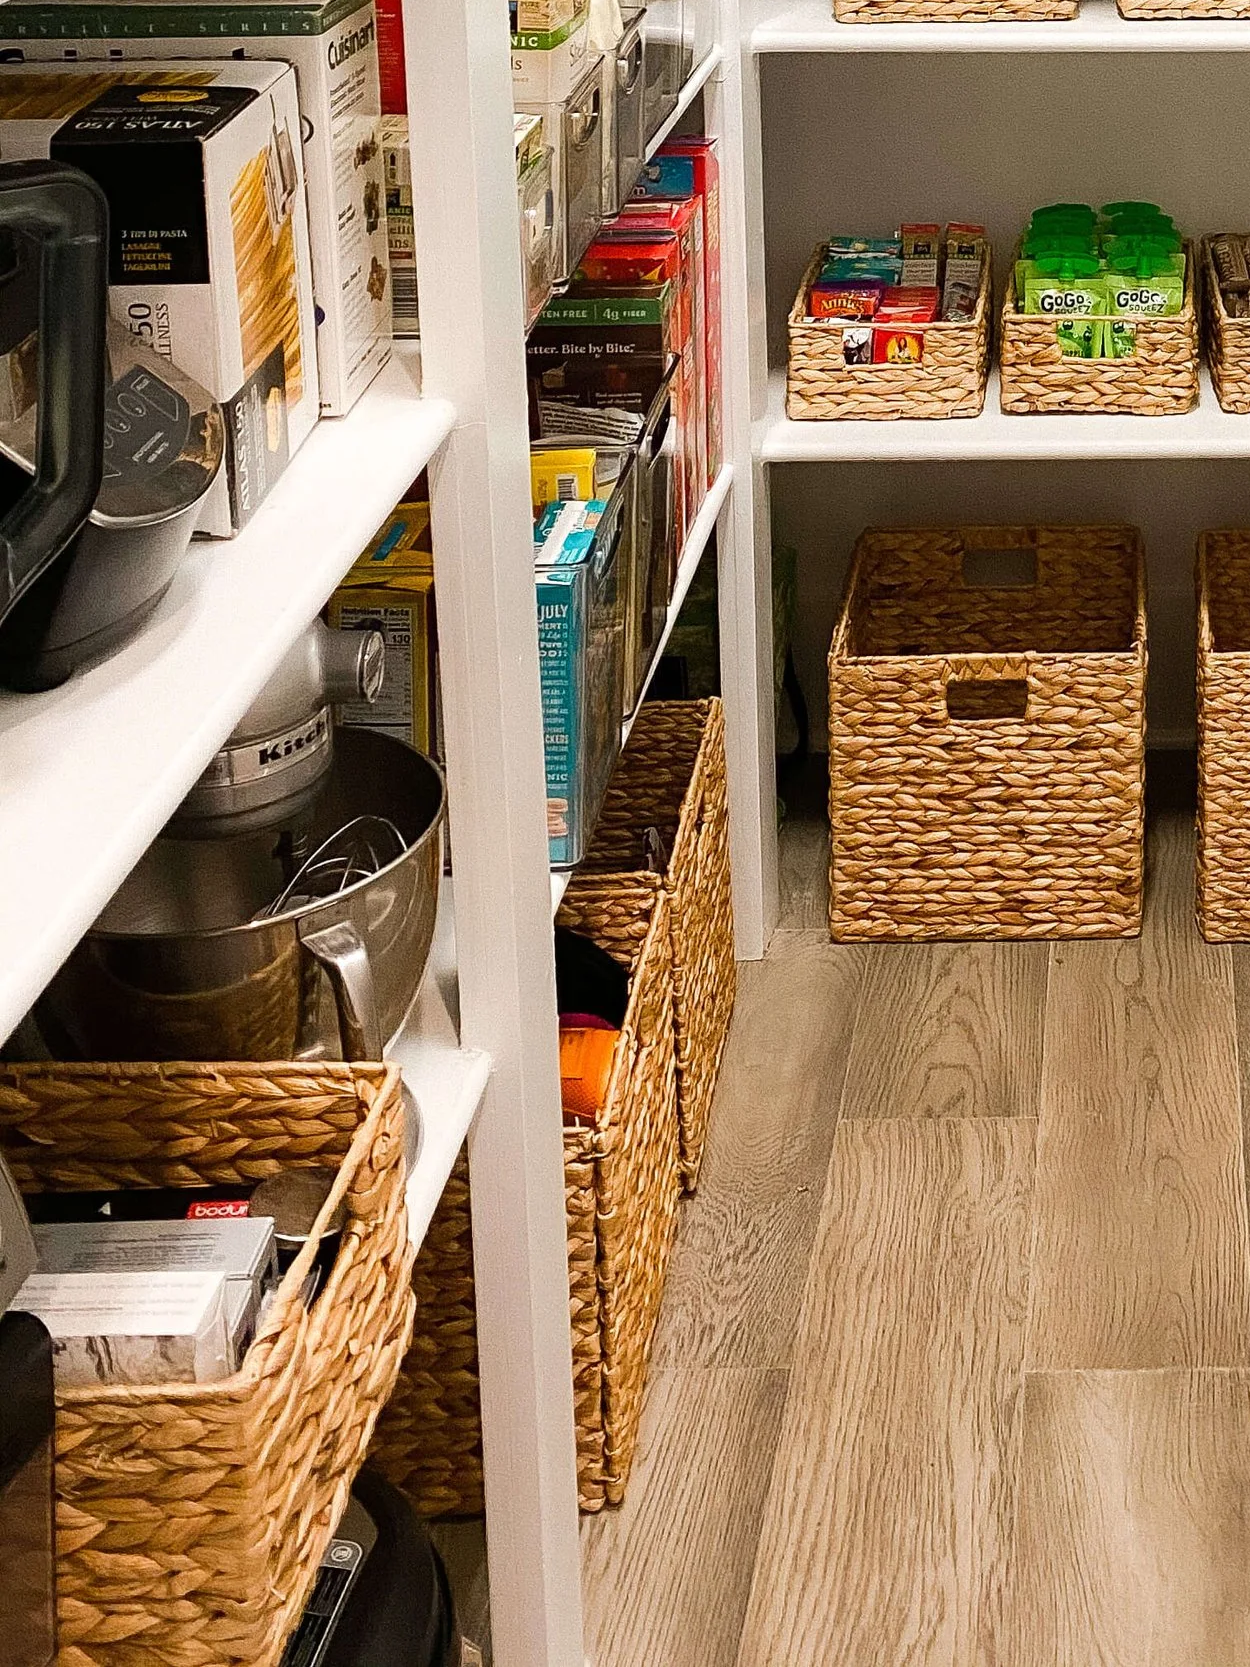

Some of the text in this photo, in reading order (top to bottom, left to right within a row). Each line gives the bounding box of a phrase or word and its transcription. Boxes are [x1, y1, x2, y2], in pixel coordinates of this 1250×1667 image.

[199, 19, 311, 33] SERIES
[124, 120, 204, 131] ATLAS
[388, 206, 412, 215] ANIC
[160, 230, 188, 238] PASTA
[821, 295, 865, 313] Annie's
[541, 309, 588, 318] TEN FREE
[602, 307, 647, 320] 4g FIBER
[128, 303, 154, 344] 50
[155, 303, 173, 361] LLNESS
[527, 344, 559, 354] etter.
[561, 343, 586, 355] Bite
[588, 343, 604, 359] by
[342, 607, 410, 616] Nutrition Facts
[538, 603, 569, 623] JULY
[258, 719, 326, 766] Kitch
